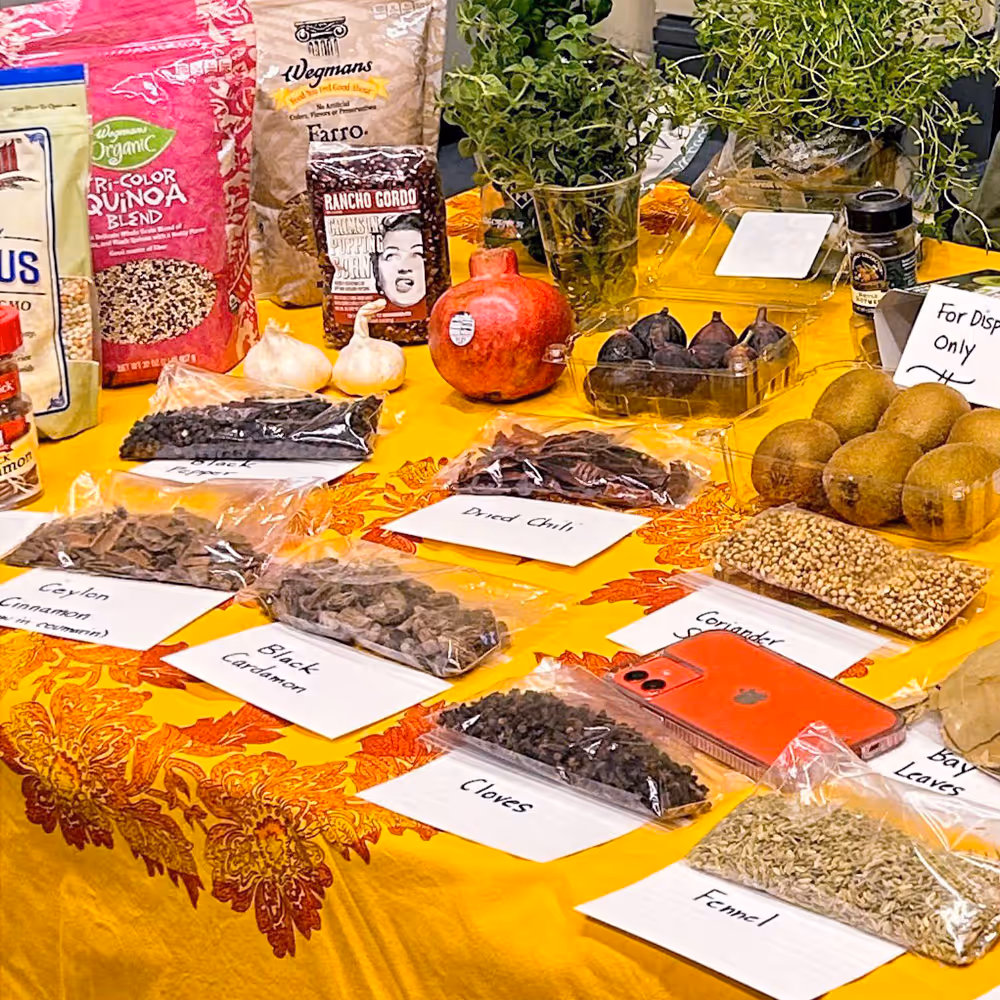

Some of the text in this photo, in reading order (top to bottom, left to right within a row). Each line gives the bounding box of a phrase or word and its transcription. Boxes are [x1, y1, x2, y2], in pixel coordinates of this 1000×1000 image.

[281, 58, 373, 88] Wegmans
[323, 187, 417, 211] RANCHO GORDO
[106, 210, 162, 230] BLEND
[937, 302, 967, 324] For
[934, 334, 976, 365] Only
[461, 506, 579, 532] Dried Chili
[38, 582, 110, 601] Ceylon
[0, 596, 91, 621] Cinnamon
[696, 611, 785, 646] Coriander
[221, 652, 307, 693] Cardamon
[257, 643, 320, 675] Black
[926, 747, 978, 778] Bay
[893, 761, 966, 796] Leaves
[460, 778, 533, 813] Cloves
[692, 888, 779, 927] Fennel
